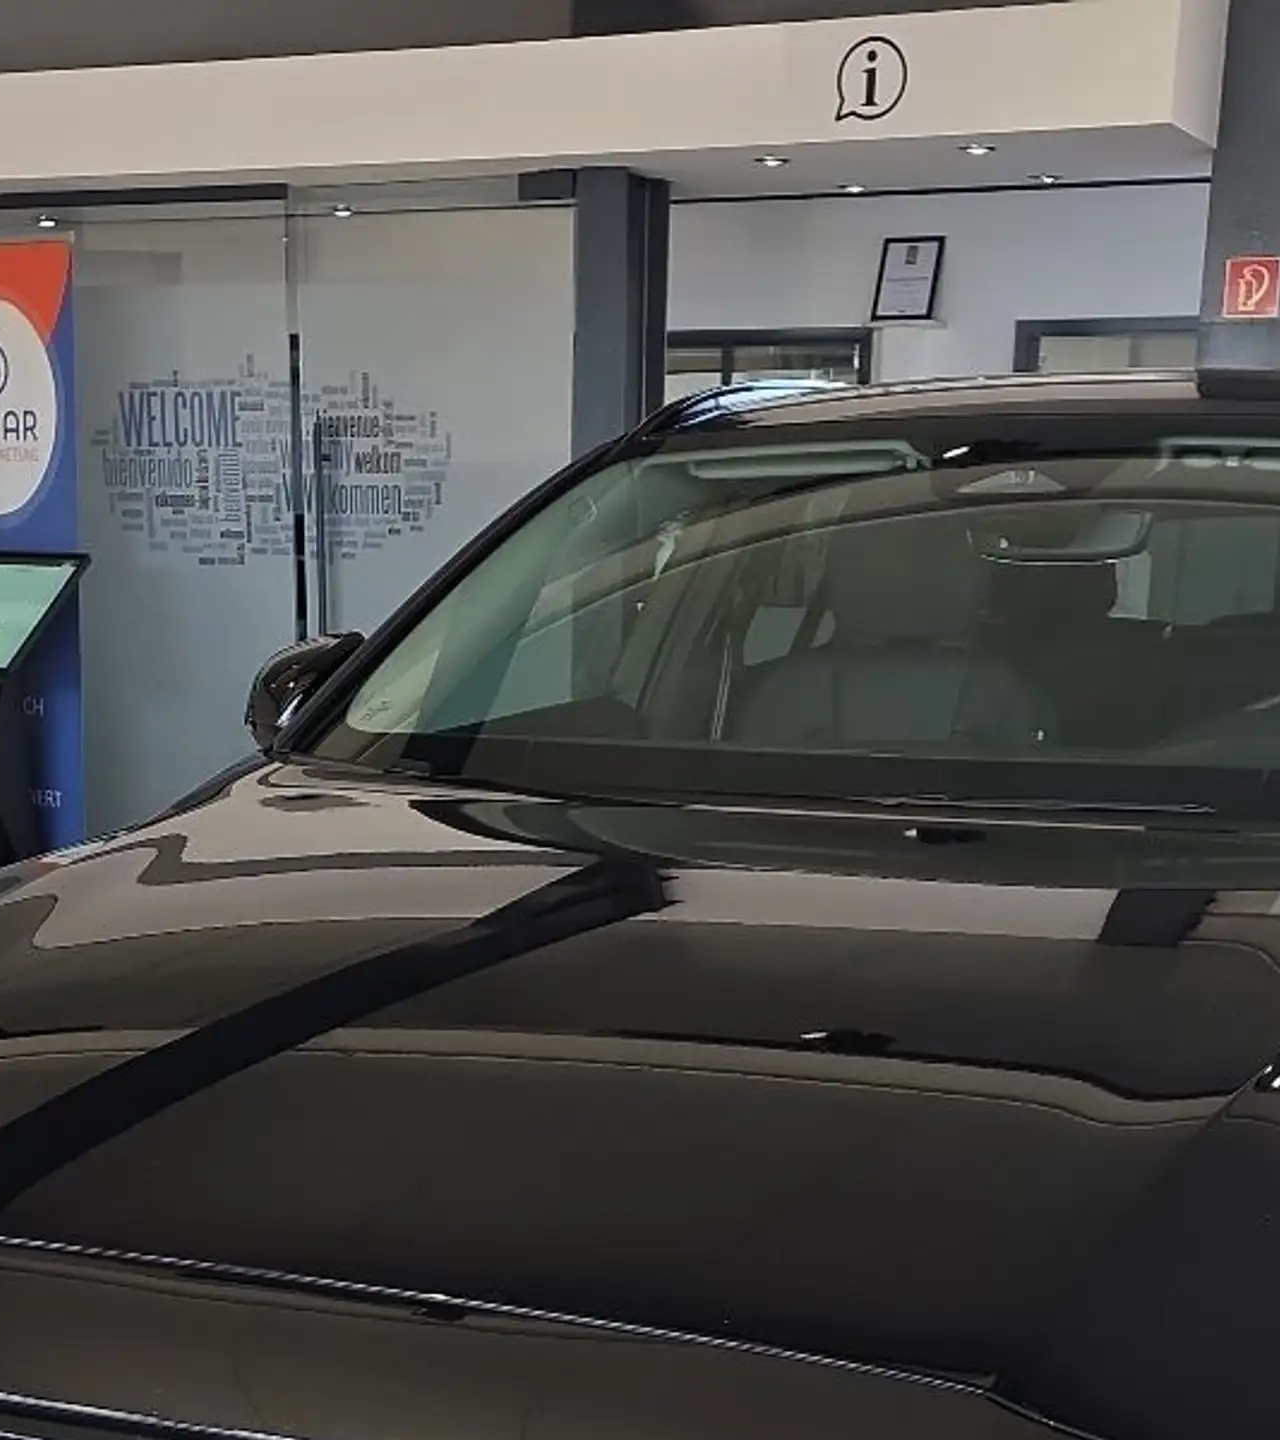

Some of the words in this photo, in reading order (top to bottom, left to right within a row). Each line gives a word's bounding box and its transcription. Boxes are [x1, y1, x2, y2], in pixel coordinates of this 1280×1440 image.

[119, 390, 243, 448] WELCOME
[102, 447, 193, 488] bienvenido
[282, 472, 402, 515] Wkommen
